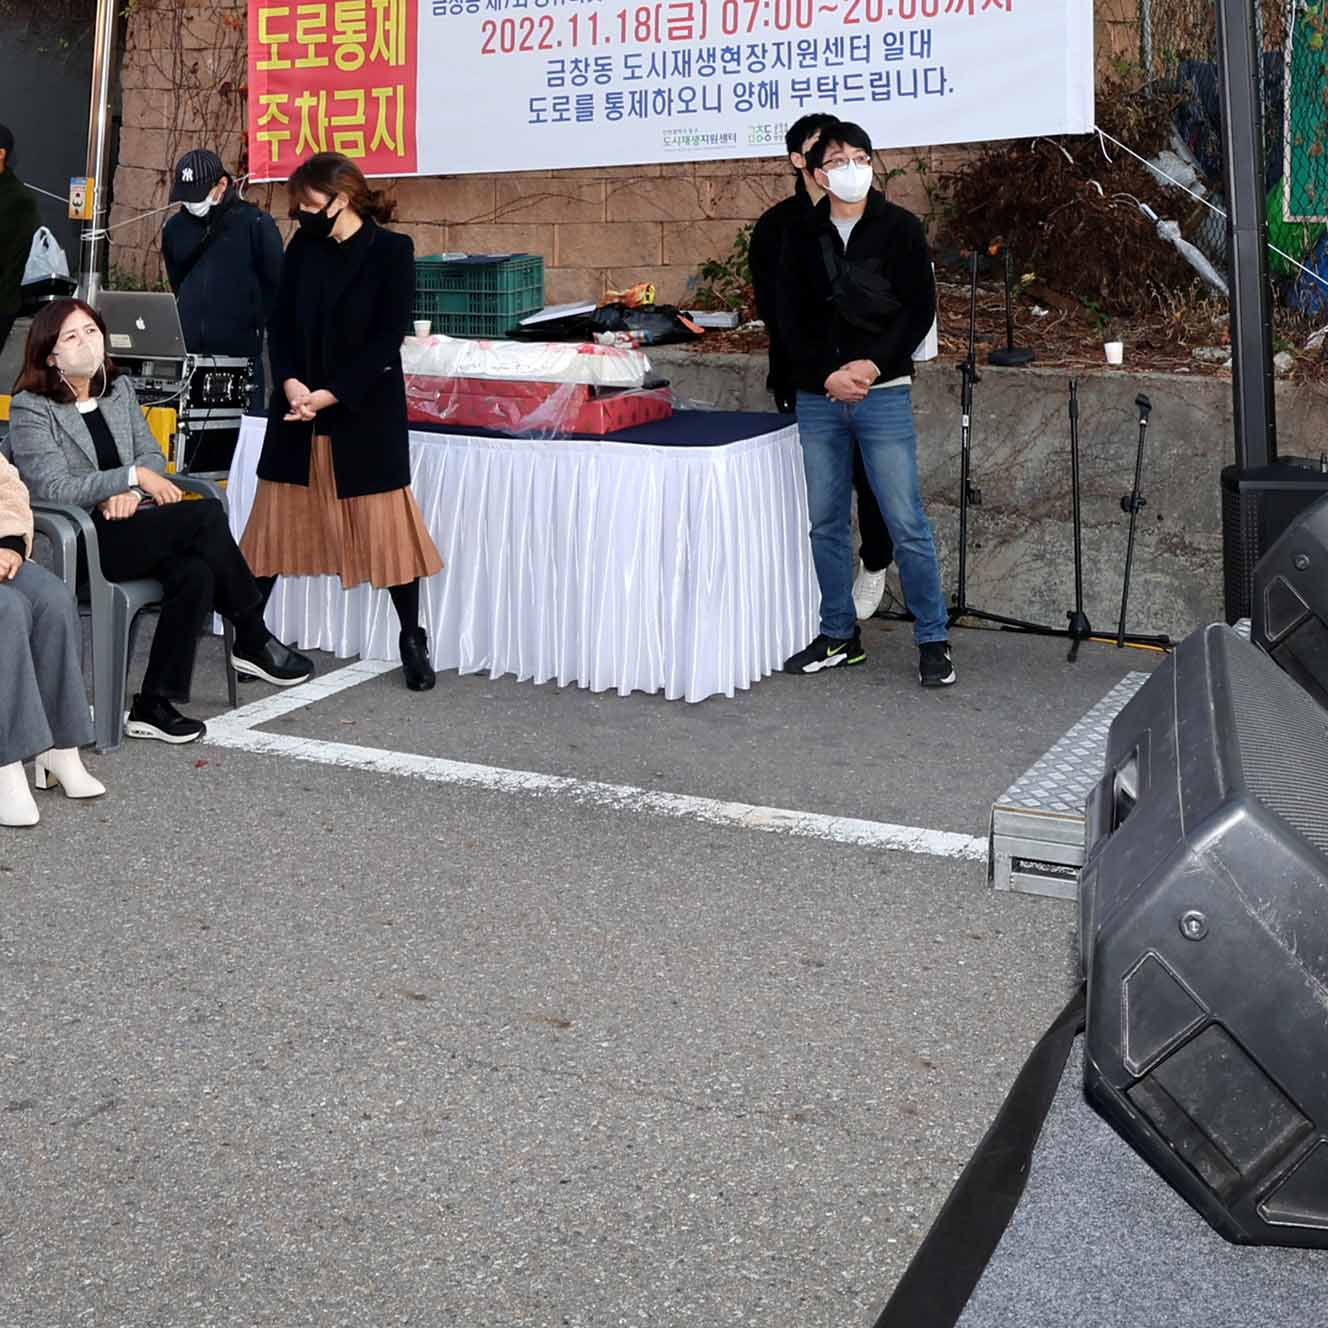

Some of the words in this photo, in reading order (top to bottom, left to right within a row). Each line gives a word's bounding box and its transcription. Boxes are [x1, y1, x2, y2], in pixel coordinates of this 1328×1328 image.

[546, 56, 613, 88] 금창동
[622, 34, 872, 82] 도시재생현장지원센터
[882, 28, 933, 61] 일대
[255, 85, 406, 162] 주차금지
[528, 94, 595, 125] 도로를
[604, 84, 723, 121] 통제하오니
[732, 77, 780, 111] 양해
[789, 66, 955, 108] 부탁드립니다.
